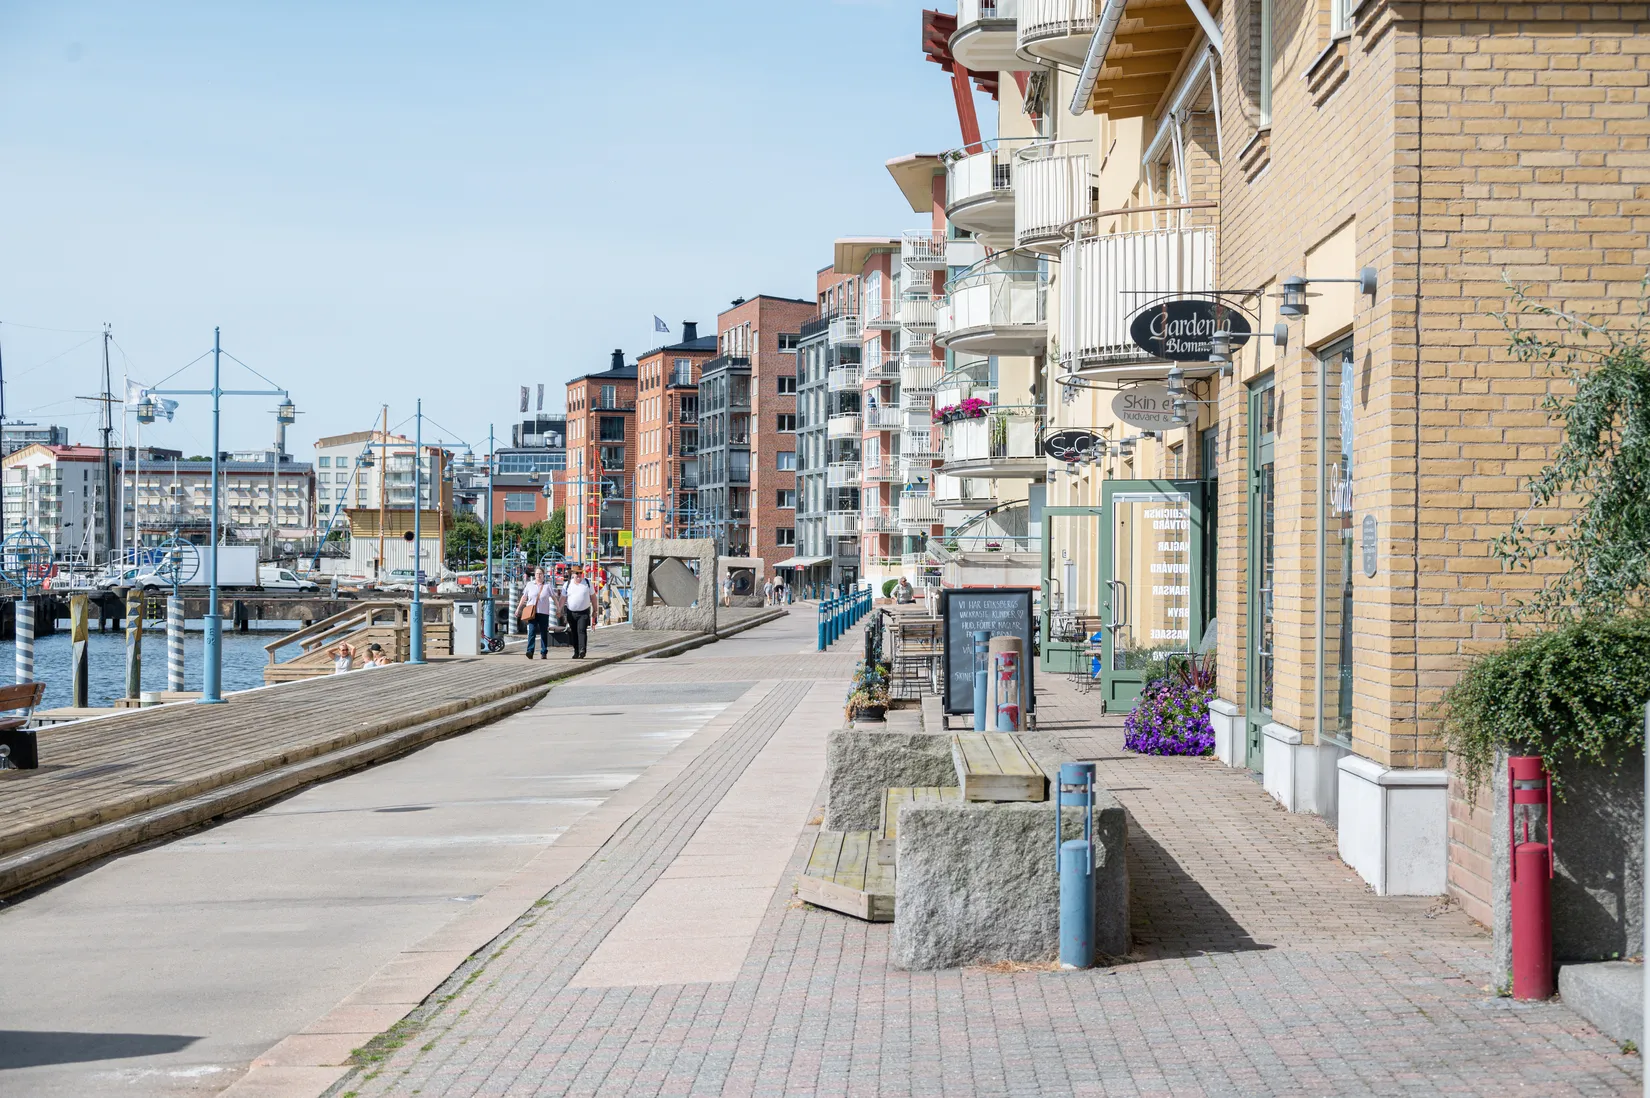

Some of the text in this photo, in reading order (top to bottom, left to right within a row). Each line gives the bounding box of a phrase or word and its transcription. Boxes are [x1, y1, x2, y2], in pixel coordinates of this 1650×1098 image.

[1123, 394, 1156, 410] Skin
[1123, 411, 1160, 422] hudvård
[958, 600, 966, 609] VI
[968, 600, 982, 609] HAR
